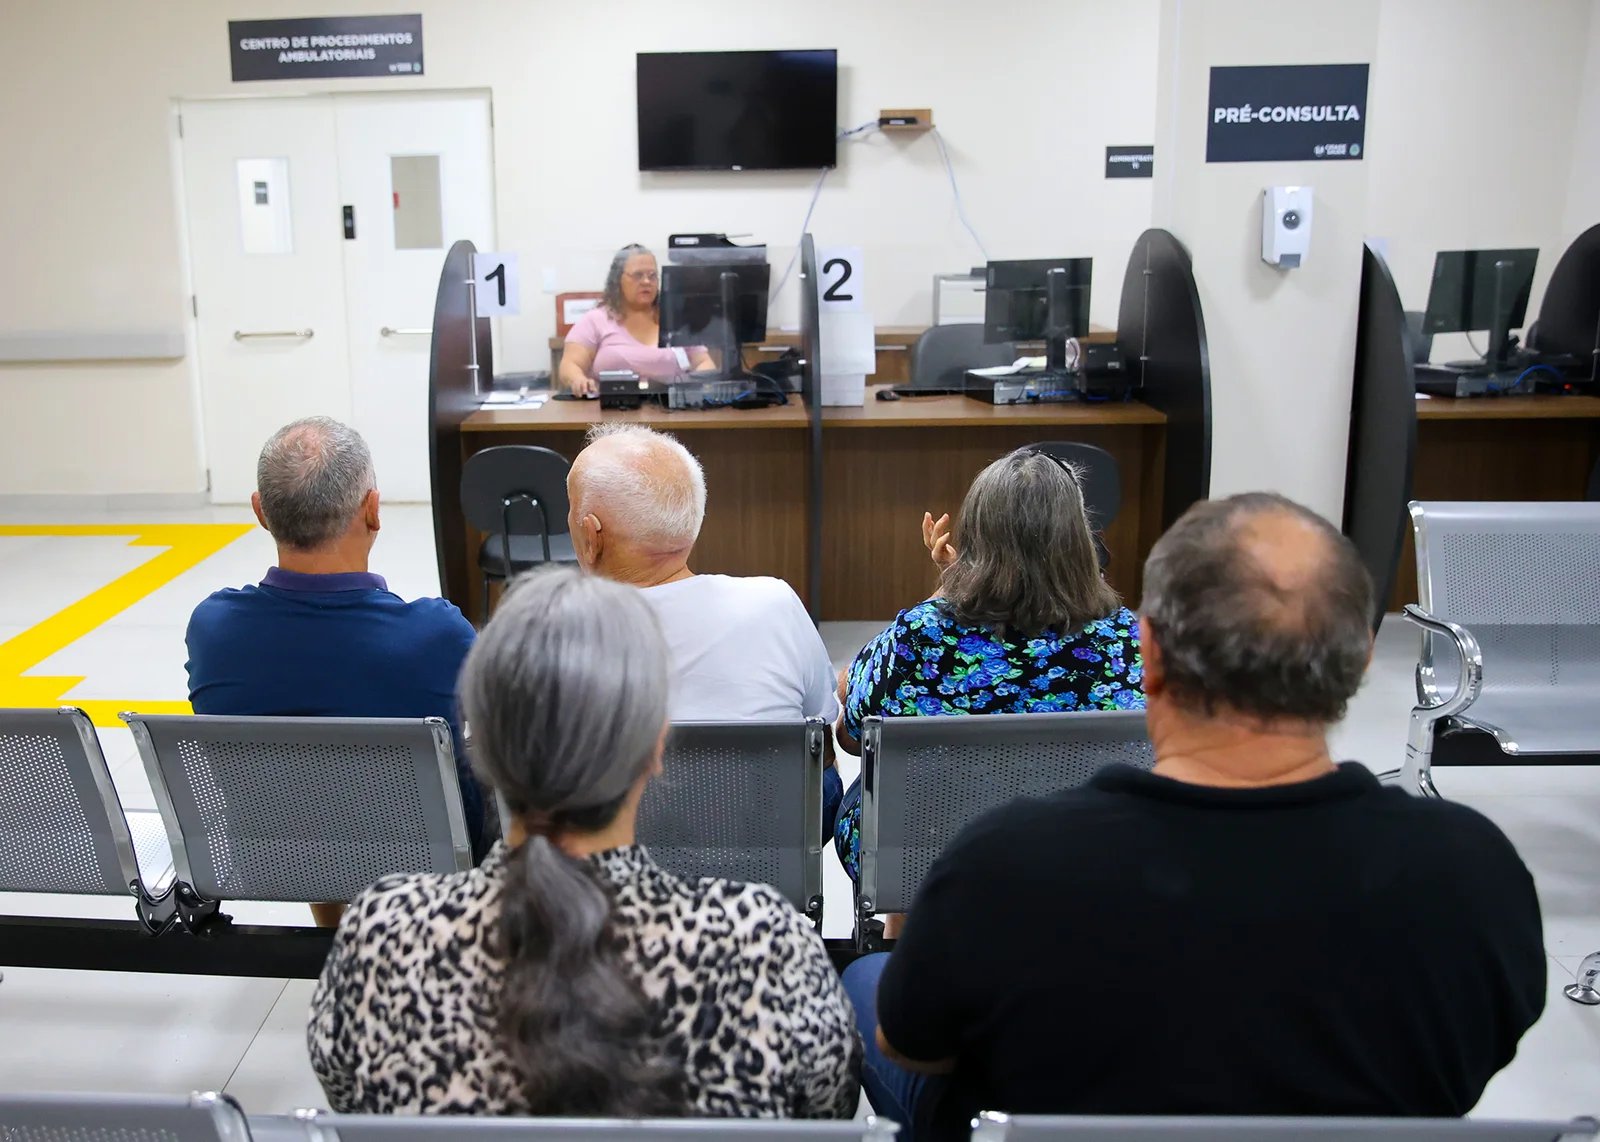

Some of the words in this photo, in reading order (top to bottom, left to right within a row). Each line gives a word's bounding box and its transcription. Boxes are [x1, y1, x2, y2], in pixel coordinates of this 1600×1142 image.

[240, 37, 290, 50] CENTRO
[291, 36, 309, 48] DE
[311, 32, 413, 47] PROCEDIMENTOS
[279, 48, 376, 63] AMBULATORIAIS
[1214, 104, 1360, 123] PRÉ-CONSULTA
[485, 263, 506, 307] 1
[823, 258, 853, 302] 2
